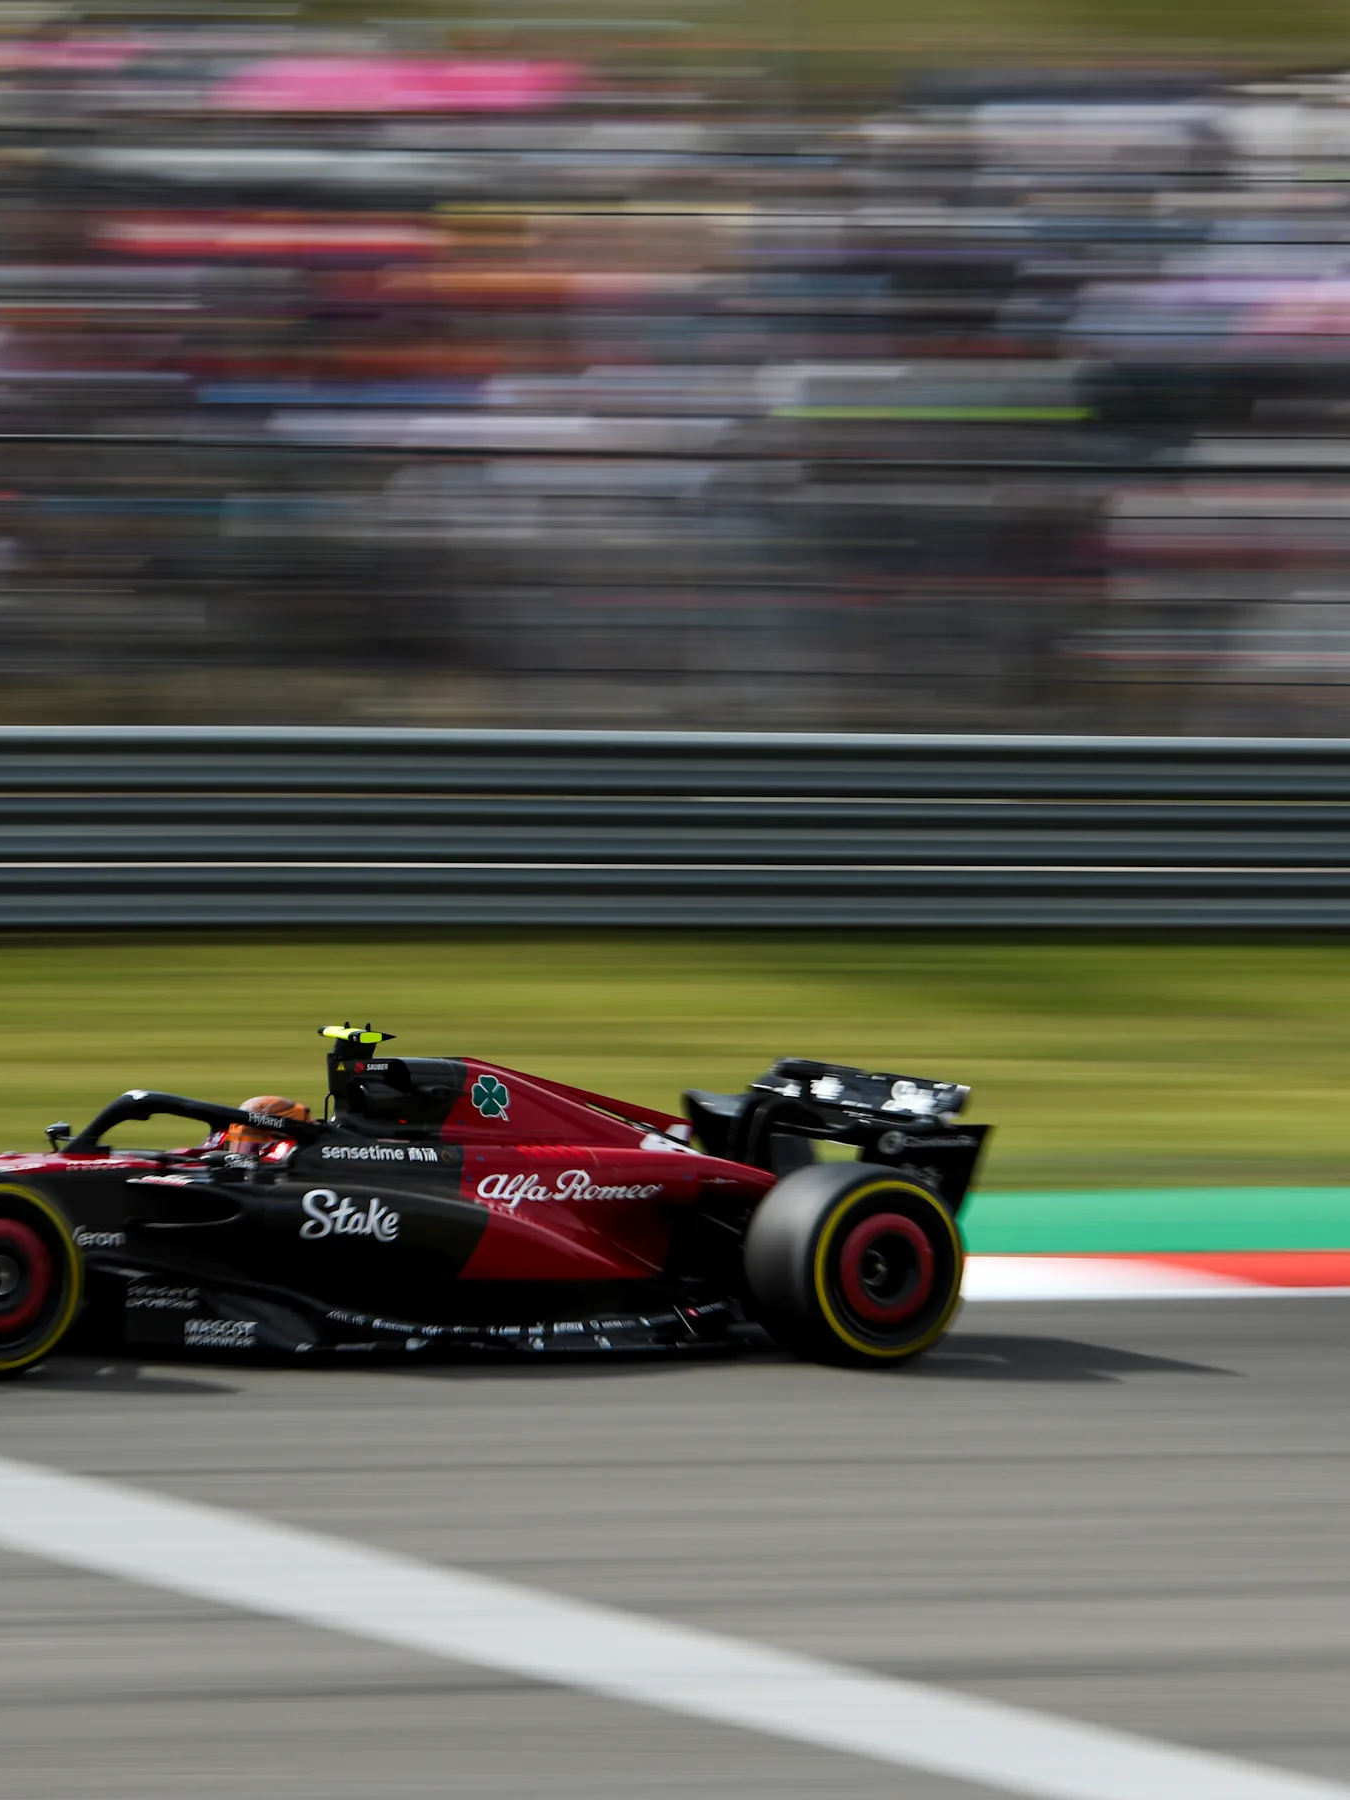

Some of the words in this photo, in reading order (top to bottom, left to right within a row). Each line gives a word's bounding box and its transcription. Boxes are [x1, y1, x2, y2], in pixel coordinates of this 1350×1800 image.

[366, 1063, 388, 1071] SAUBER
[321, 1145, 405, 1160] sensetime
[477, 1173, 552, 1208] Alfa
[552, 1169, 665, 1201] Romeo
[299, 1188, 400, 1242] Stake
